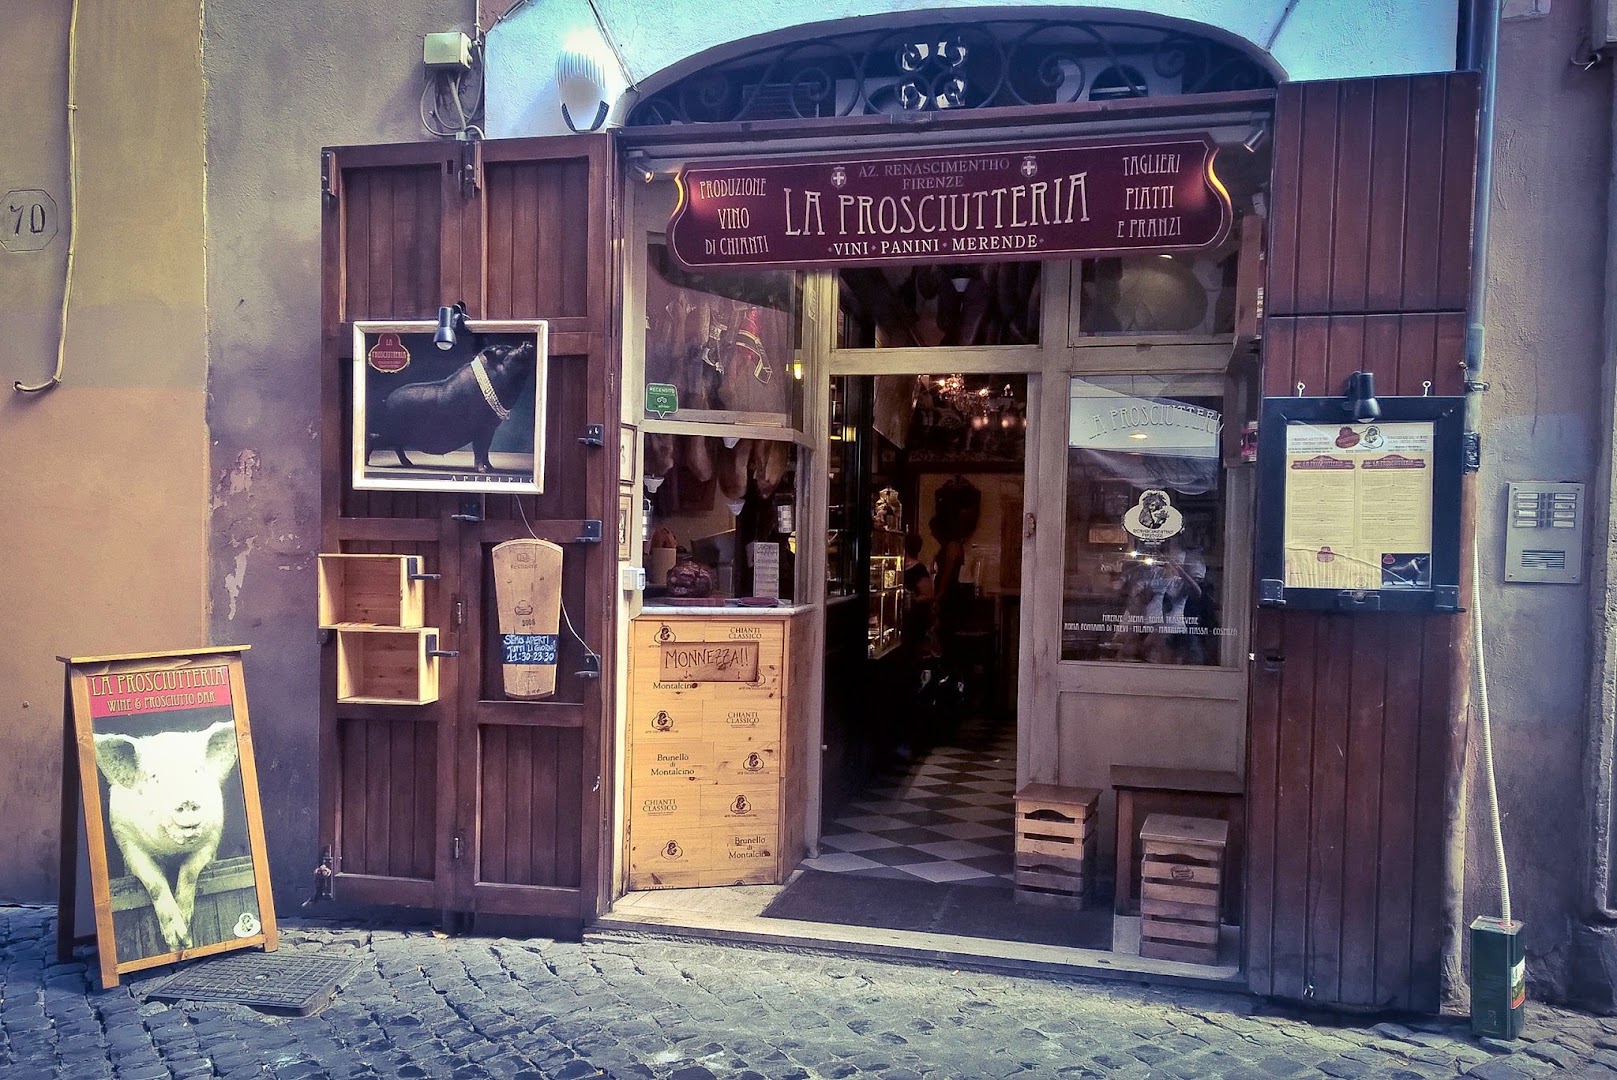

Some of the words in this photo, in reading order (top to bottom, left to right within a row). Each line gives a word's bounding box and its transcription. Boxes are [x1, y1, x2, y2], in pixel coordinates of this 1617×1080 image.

[858, 165, 879, 178] AZ.
[884, 158, 1010, 176] RENASCIMENTHO
[1122, 153, 1181, 176] TAGLIERI
[700, 179, 767, 199] PRODUZIONE
[902, 175, 964, 190] FIRENZE
[783, 187, 826, 236] LA
[838, 171, 1090, 236] PROSCIUTTERIA
[1125, 186, 1175, 210] PIATTI
[9, 203, 46, 235] 70
[717, 207, 751, 230] VINO
[1117, 220, 1125, 238] E
[1129, 216, 1182, 238] PRANZI
[705, 238, 717, 255] DI
[719, 235, 770, 256] CHIANTI
[833, 242, 869, 256] VINI
[881, 238, 940, 254] PANINI
[951, 234, 1038, 251] MERENDE
[664, 648, 749, 669] MONNEZZA!!
[91, 676, 114, 696] LA
[117, 668, 226, 694] PROSCIUTTERIA
[652, 682, 698, 690] Montalcin
[107, 698, 132, 713] WINE
[135, 697, 142, 710] &
[144, 693, 195, 709] PROSCIUTTO
[197, 691, 216, 705] BAR
[657, 753, 689, 762] Brunello
[650, 767, 695, 776] Montalcino
[734, 836, 766, 845] Brunello
[728, 850, 771, 860] Montalcin
